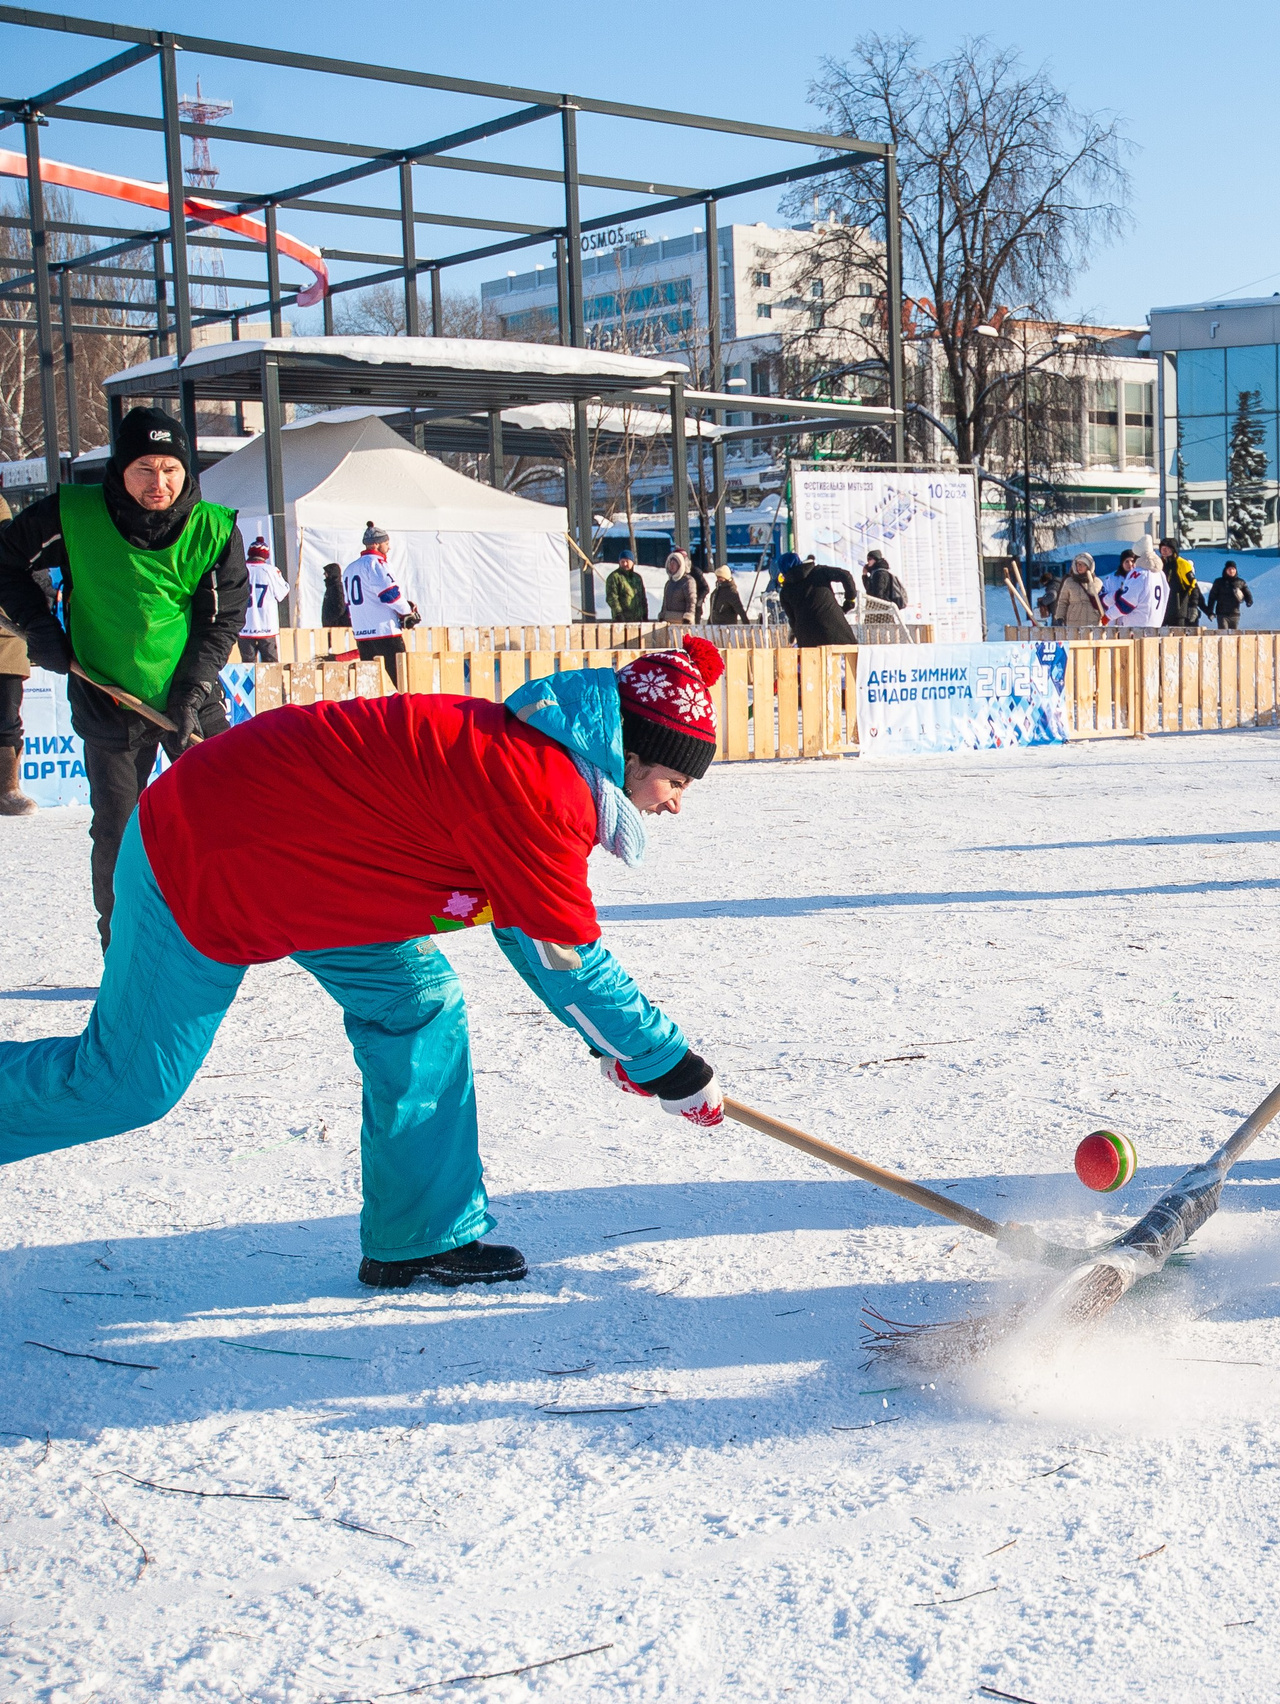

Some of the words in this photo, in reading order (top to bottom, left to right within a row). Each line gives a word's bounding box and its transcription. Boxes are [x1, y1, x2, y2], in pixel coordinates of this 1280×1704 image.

[581, 228, 624, 252] OSMOS
[928, 483, 943, 499] 10
[944, 489, 967, 499] 2024
[344, 575, 365, 606] 10
[1154, 585, 1162, 610] 9
[1043, 642, 1057, 653] 10
[868, 669, 907, 686] ДЕНЬ
[911, 667, 968, 683] ЗИМНИХ
[975, 664, 1051, 699] 2024
[868, 688, 917, 704] ВИДОВ
[922, 685, 973, 700] СПОРТА
[22, 735, 75, 755] НИХ
